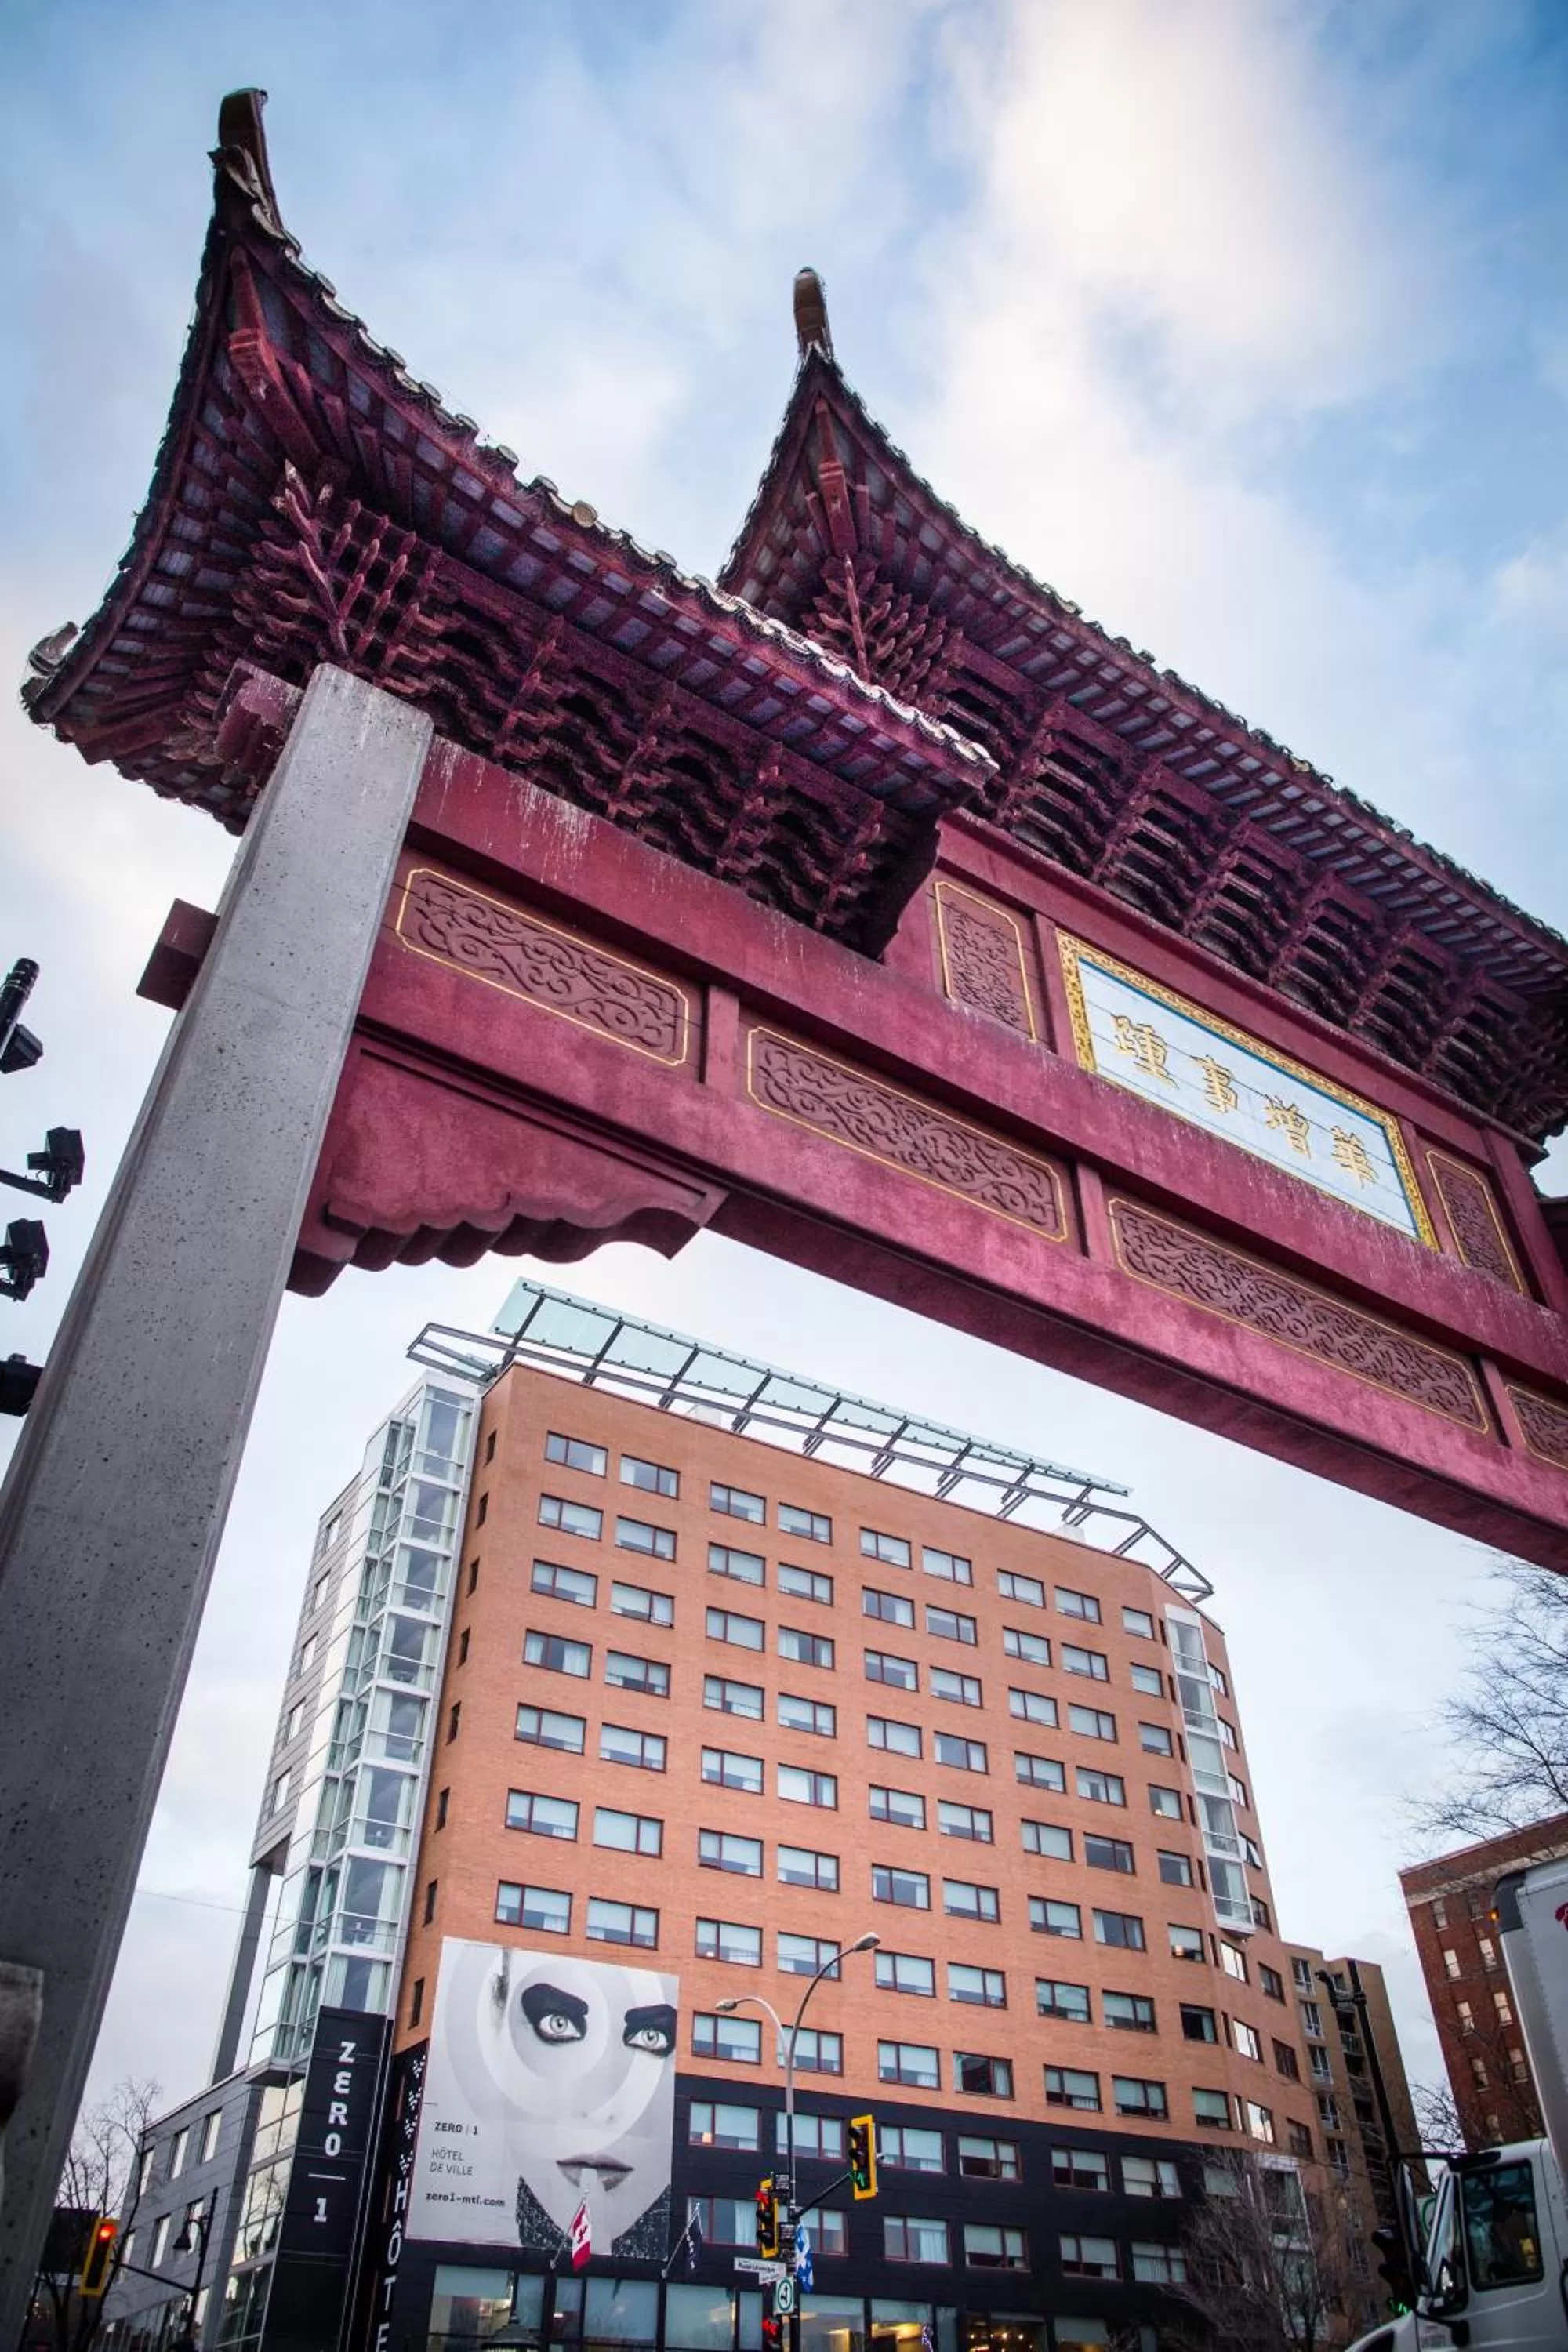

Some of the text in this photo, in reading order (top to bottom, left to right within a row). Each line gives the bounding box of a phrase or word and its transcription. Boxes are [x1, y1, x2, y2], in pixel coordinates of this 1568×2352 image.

[313, 2042, 356, 2223] ZERO 1
[434, 2121, 478, 2136] ZERO 1
[431, 2146, 463, 2161] HÔTEL
[430, 2161, 474, 2176] DE VILLE
